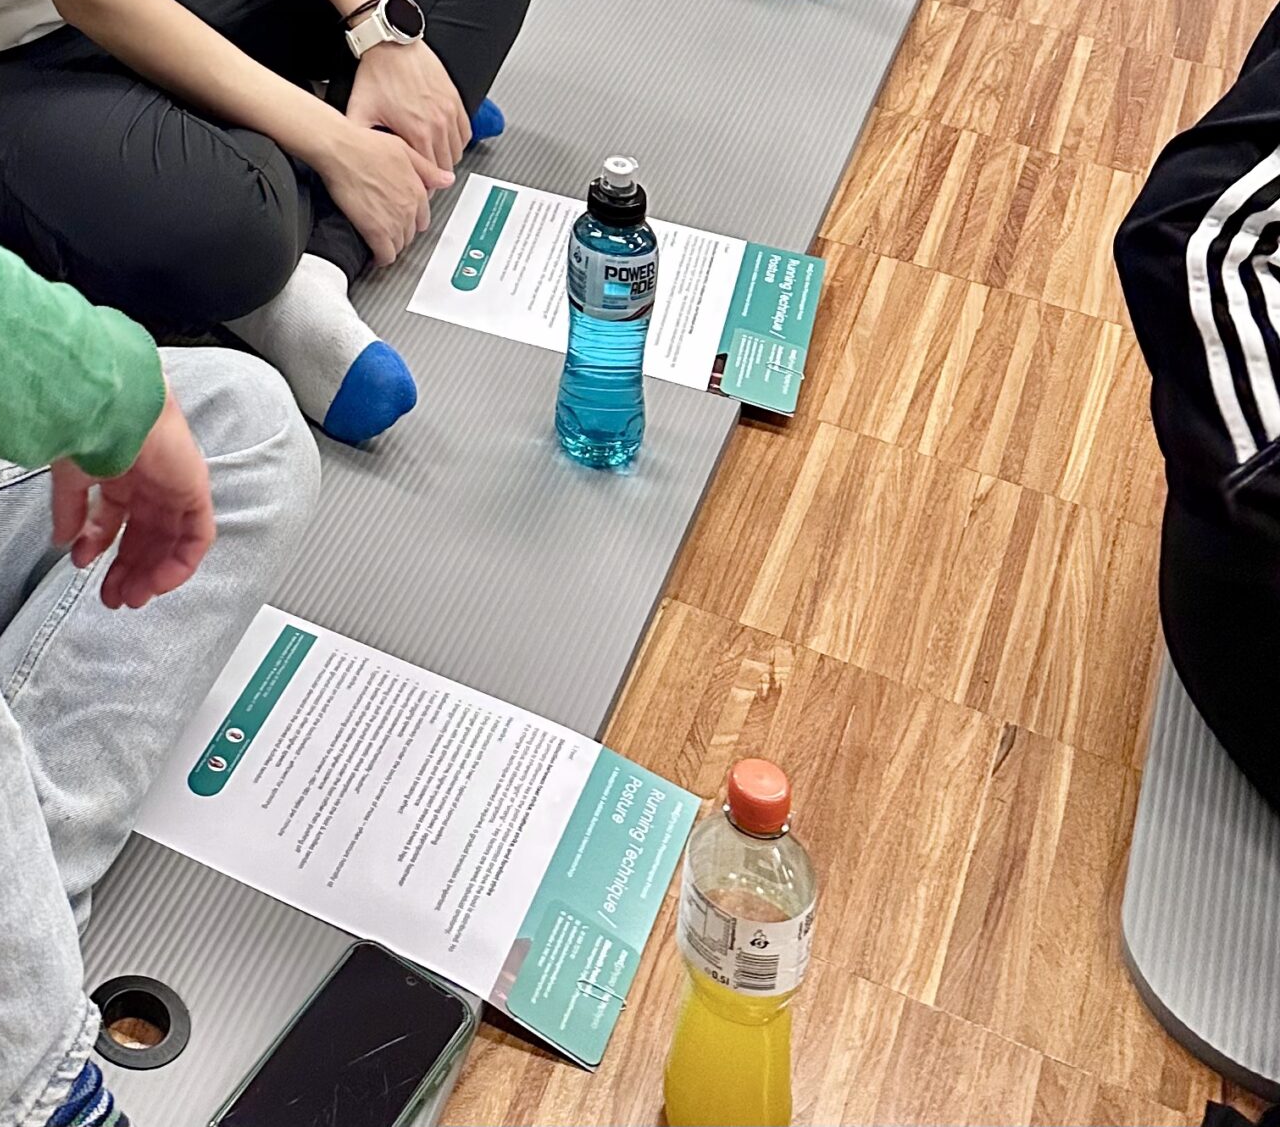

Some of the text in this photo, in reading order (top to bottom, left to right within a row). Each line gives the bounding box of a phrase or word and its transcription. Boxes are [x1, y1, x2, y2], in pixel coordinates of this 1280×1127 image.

[604, 261, 655, 282] POWER
[630, 275, 655, 295] ADE
[779, 258, 800, 290] Running
[771, 291, 793, 331] Technique
[612, 775, 643, 824] Posture
[629, 788, 666, 843] Running
[603, 843, 644, 913] Technique
